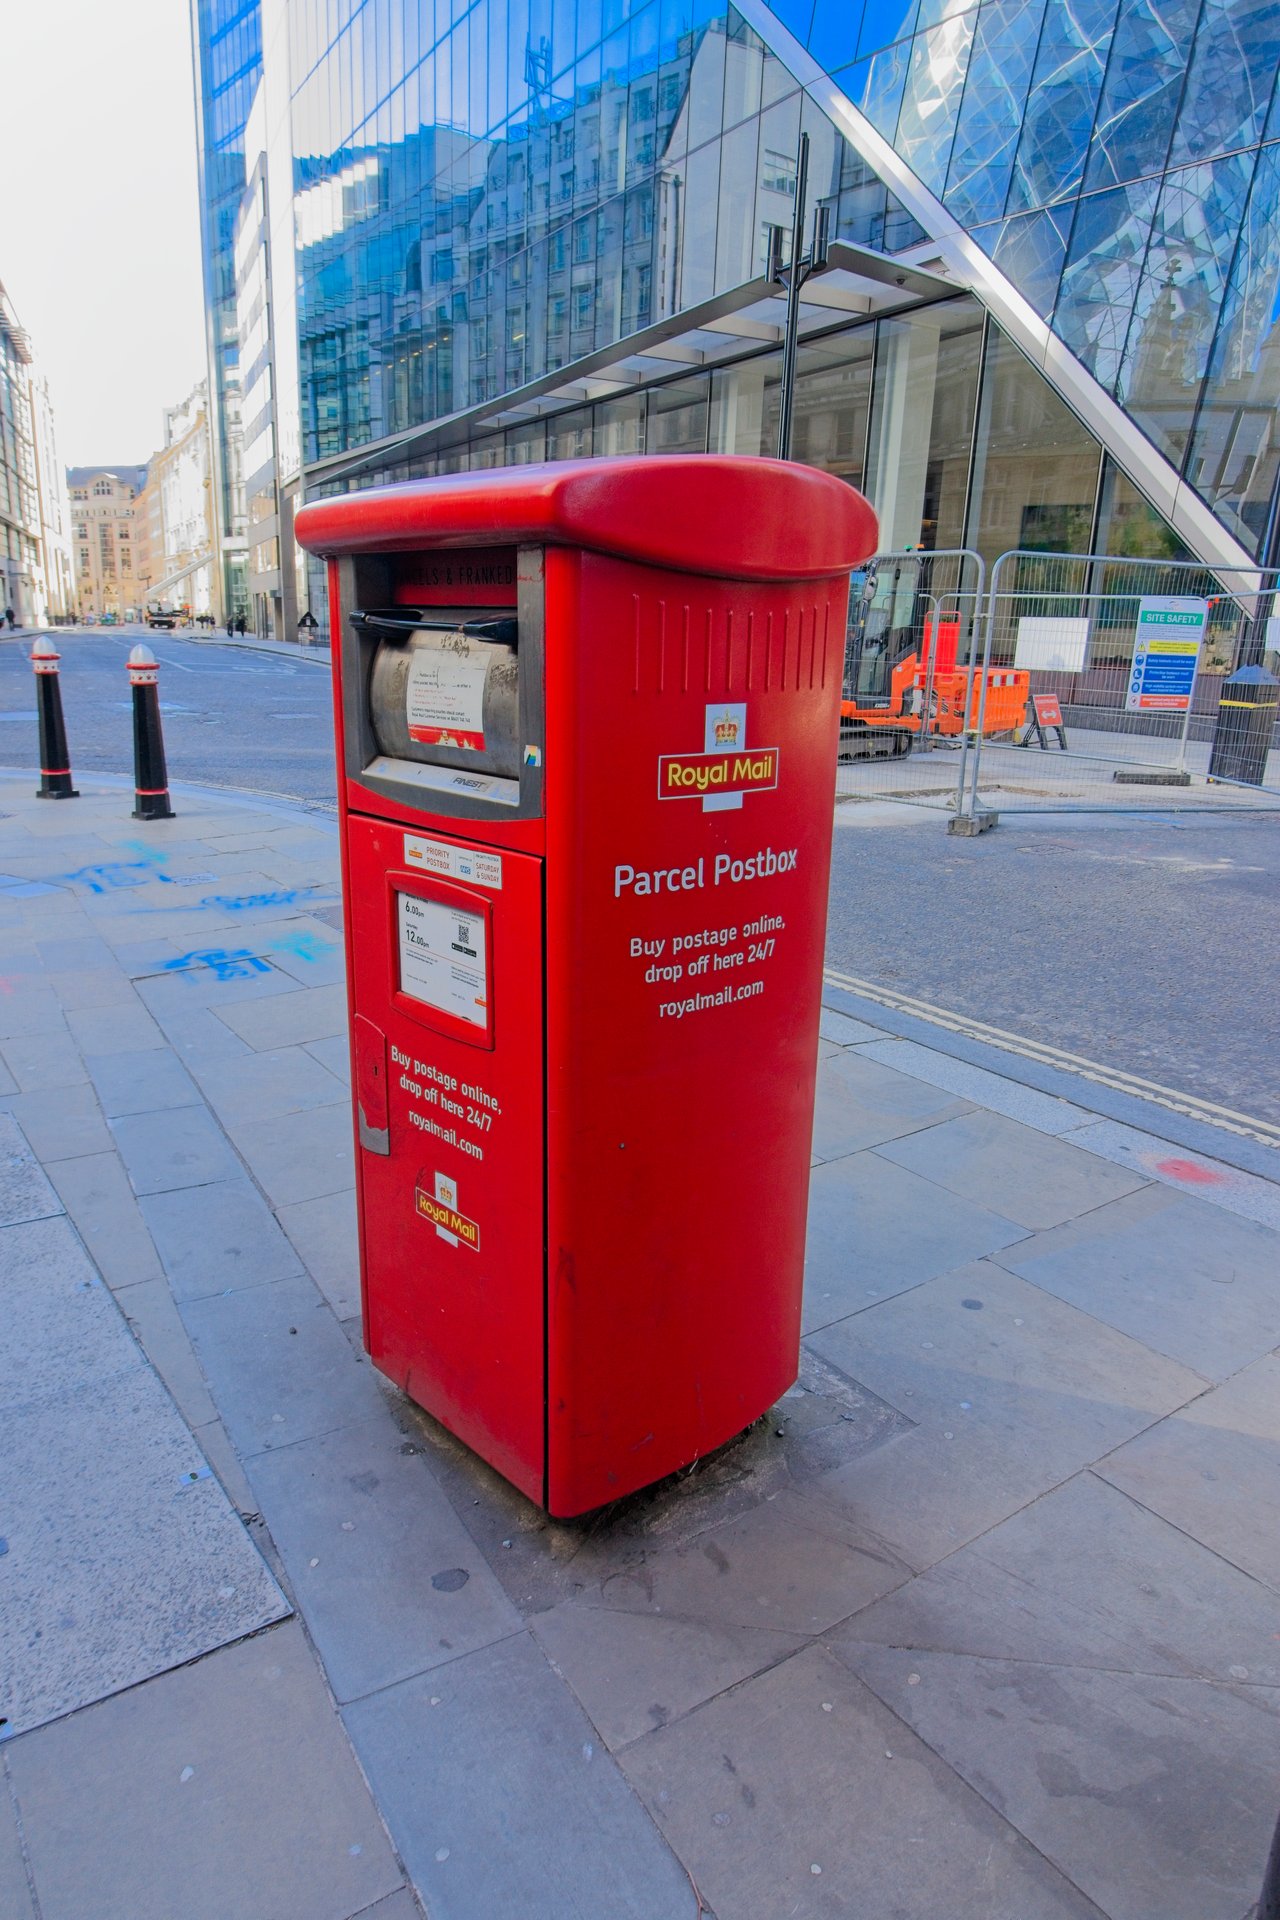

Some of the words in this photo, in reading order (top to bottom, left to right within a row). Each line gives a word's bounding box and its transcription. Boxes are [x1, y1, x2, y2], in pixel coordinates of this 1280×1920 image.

[459, 565, 513, 585] FRANKED
[1146, 613, 1166, 623] SITE
[1166, 614, 1199, 624] SAFETY
[668, 760, 728, 790] Royal
[732, 756, 772, 782] Mail
[426, 846, 450, 859] PRIORITY
[426, 857, 450, 870] POSTBOX
[475, 862, 499, 874] SATURDAY
[481, 872, 499, 883] SUNDAY
[614, 858, 705, 898] Parcel
[714, 848, 798, 886] Postbox
[630, 938, 666, 957] Buy
[672, 928, 737, 955] postage
[742, 914, 786, 938] online,
[645, 964, 683, 983] drop
[687, 955, 710, 976] off
[713, 953, 744, 971] here
[747, 939, 776, 963] 24/7
[659, 980, 764, 1019] royalmail.com
[391, 1045, 411, 1070] Buy
[413, 1059, 458, 1091] postage
[461, 1083, 502, 1115] online,
[400, 1074, 422, 1098] drop
[424, 1087, 439, 1105] off
[440, 1092, 464, 1118] here
[466, 1105, 492, 1132] 24/7
[408, 1110, 483, 1161] royalmail.com
[419, 1194, 449, 1225] Royal
[451, 1214, 475, 1242] Mail
